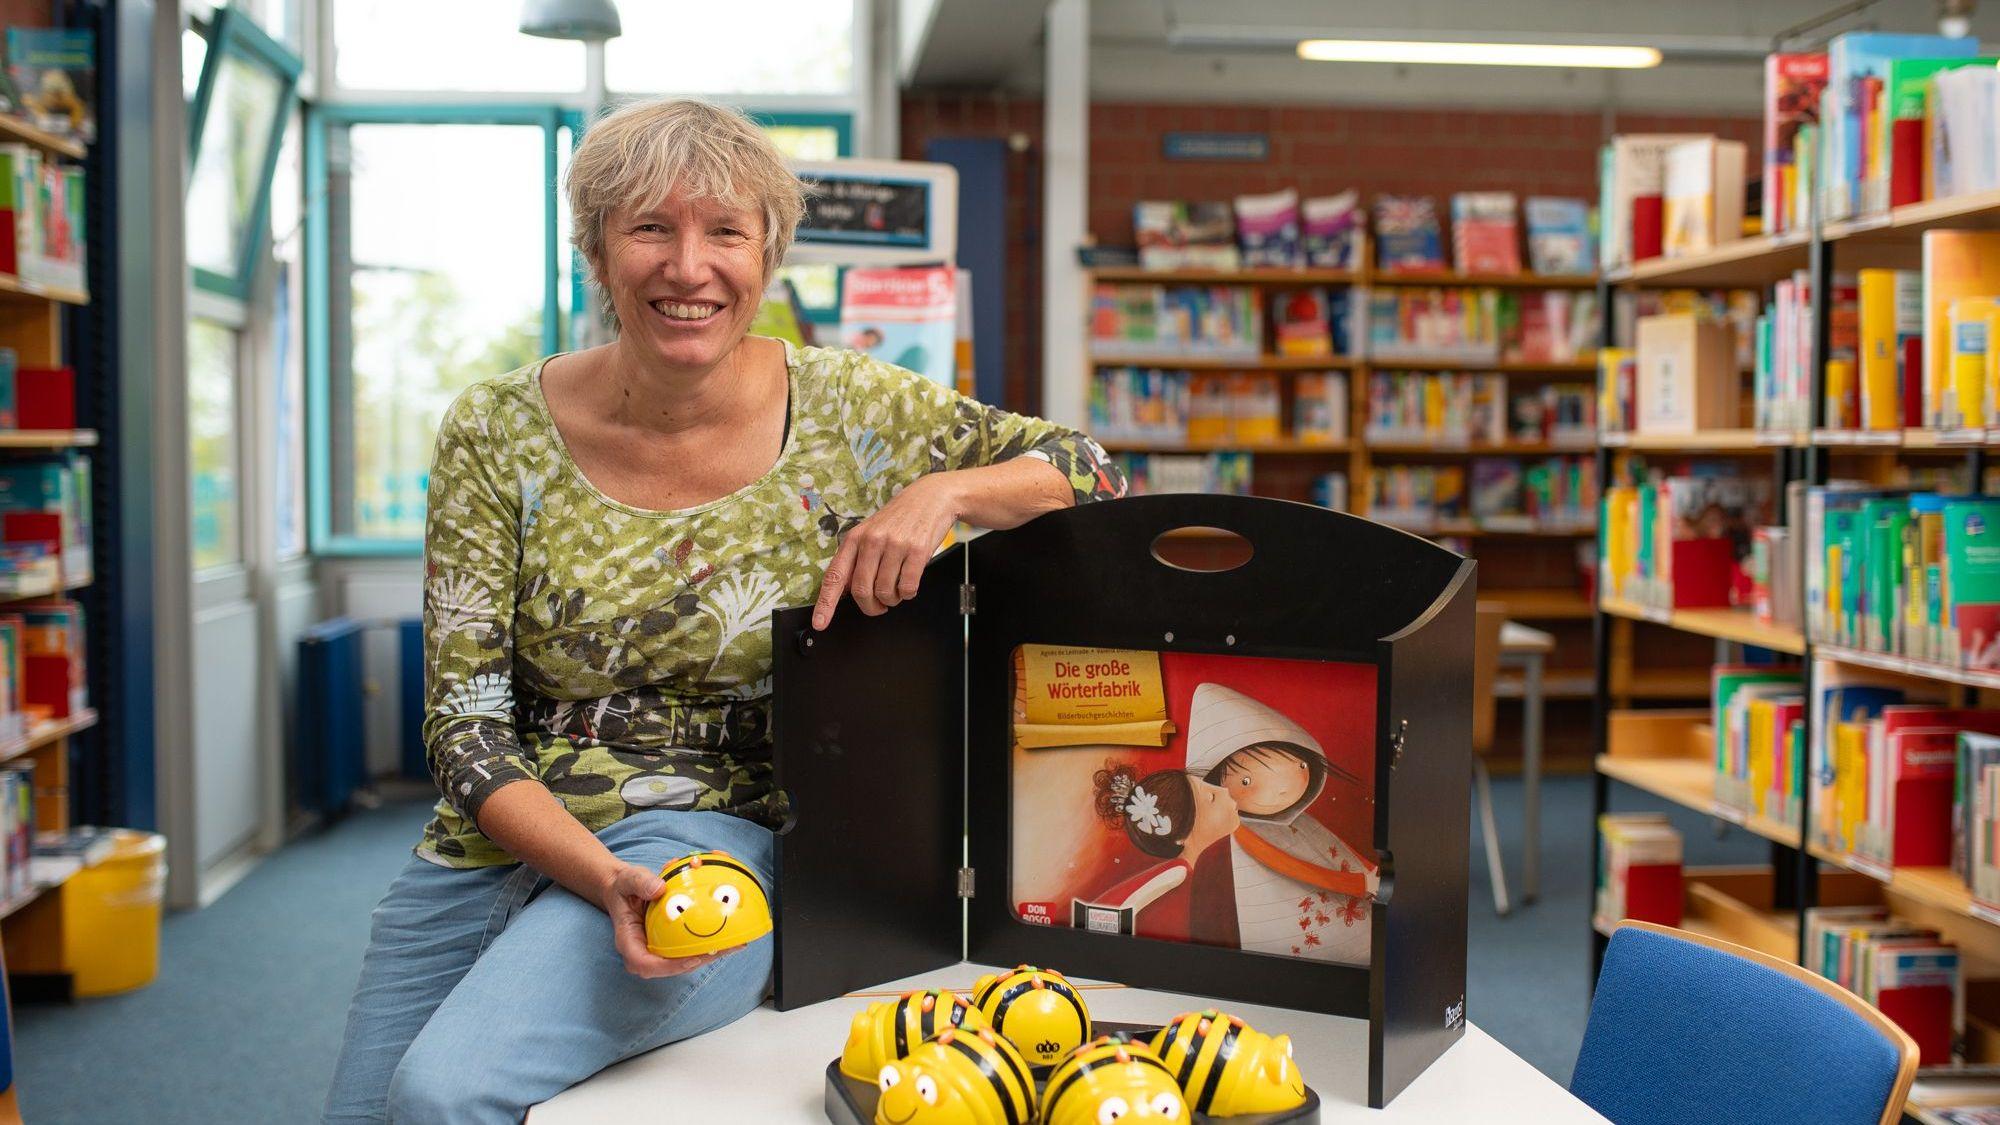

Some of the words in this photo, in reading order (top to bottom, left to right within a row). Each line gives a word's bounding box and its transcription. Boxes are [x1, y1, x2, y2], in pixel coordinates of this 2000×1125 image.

[1055, 662, 1081, 678] Die
[1085, 660, 1130, 679] große
[1047, 680, 1142, 699] Wörterfabrik
[1057, 711, 1134, 720] Bilderbuchgeschichten
[1027, 904, 1047, 915] DON
